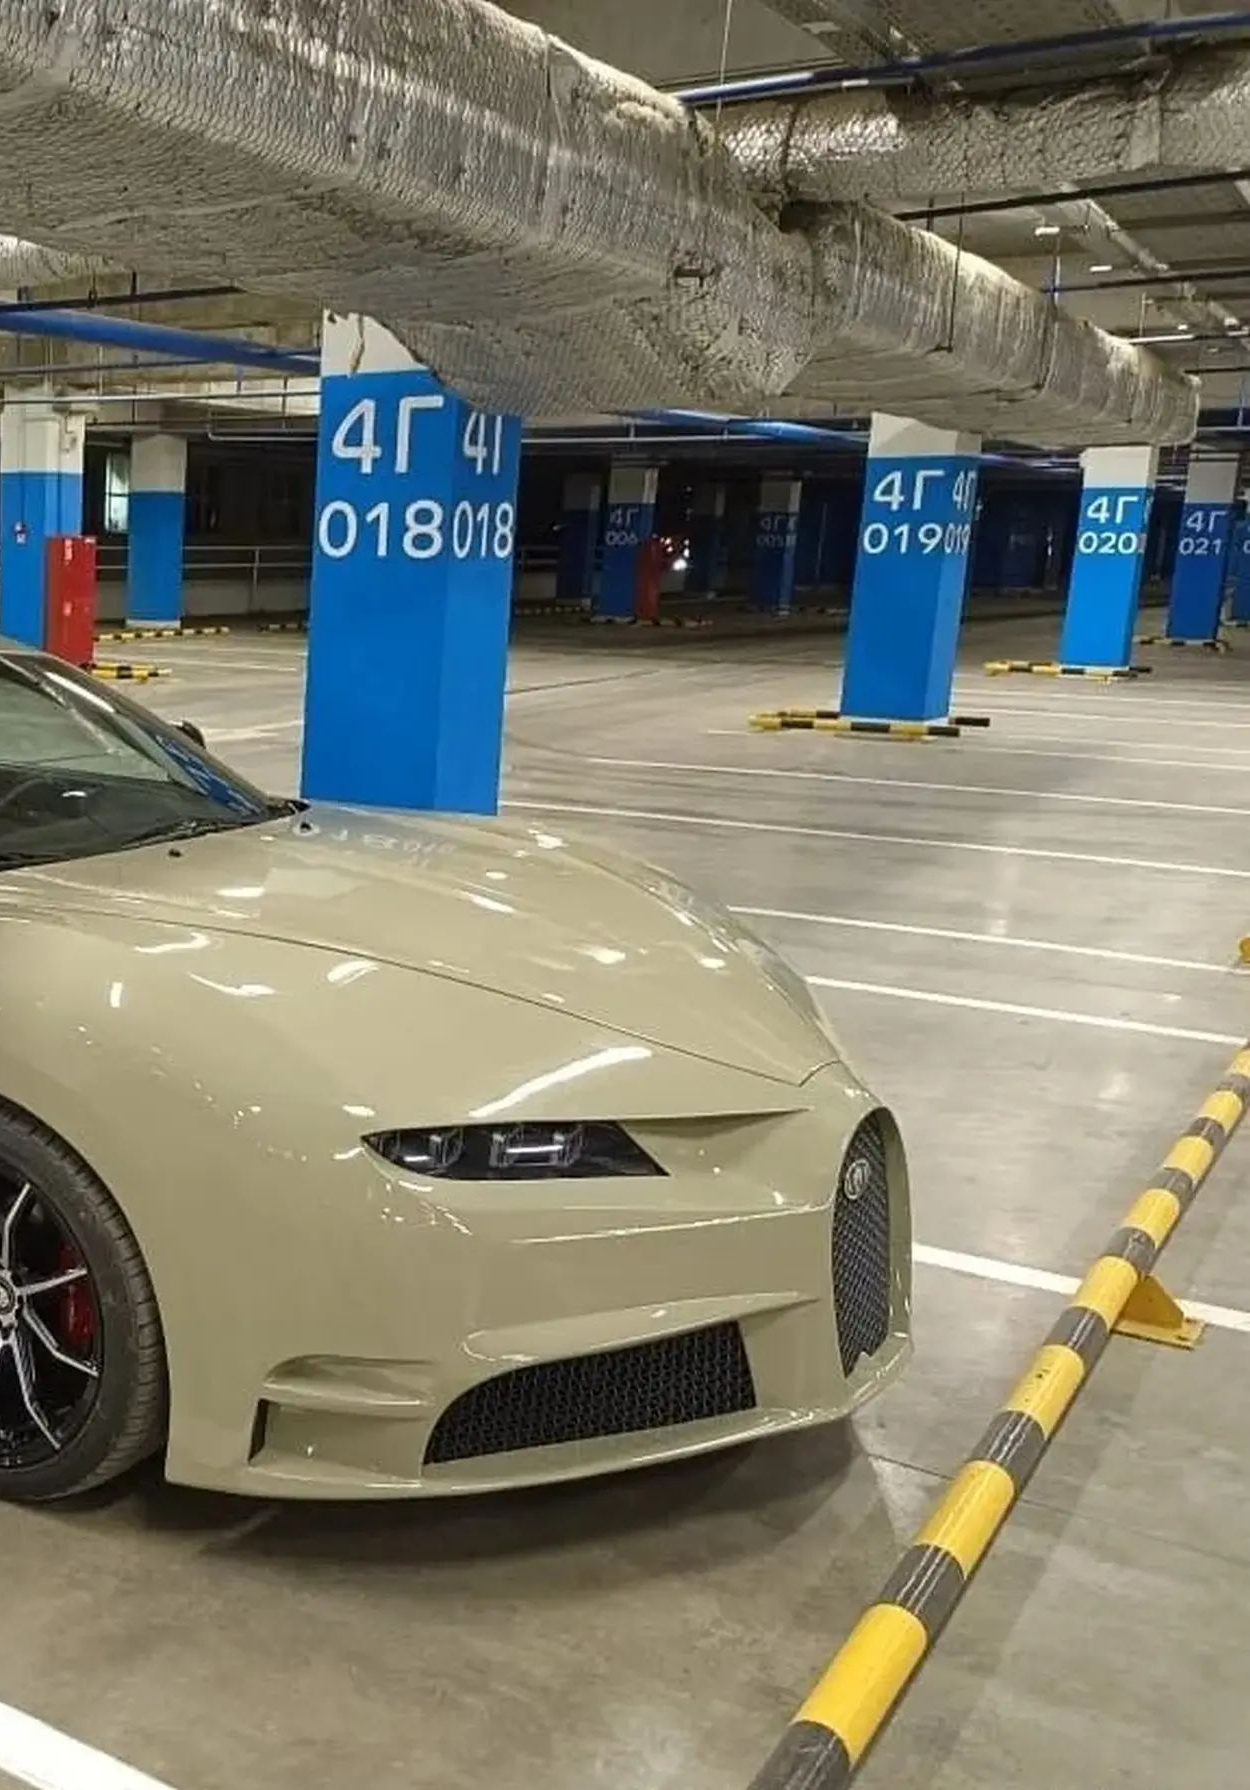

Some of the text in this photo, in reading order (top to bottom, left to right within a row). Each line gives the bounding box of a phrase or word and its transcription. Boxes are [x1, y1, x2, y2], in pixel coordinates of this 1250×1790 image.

[332, 395, 444, 474] 4Г
[873, 469, 945, 511] 4Г
[1087, 496, 1139, 524] 4Г
[1186, 510, 1228, 532] 4Г
[318, 500, 443, 559] 018
[453, 501, 514, 558] 018
[863, 522, 943, 554] 019
[1078, 532, 1138, 554] 020
[1179, 538, 1222, 555] 021
